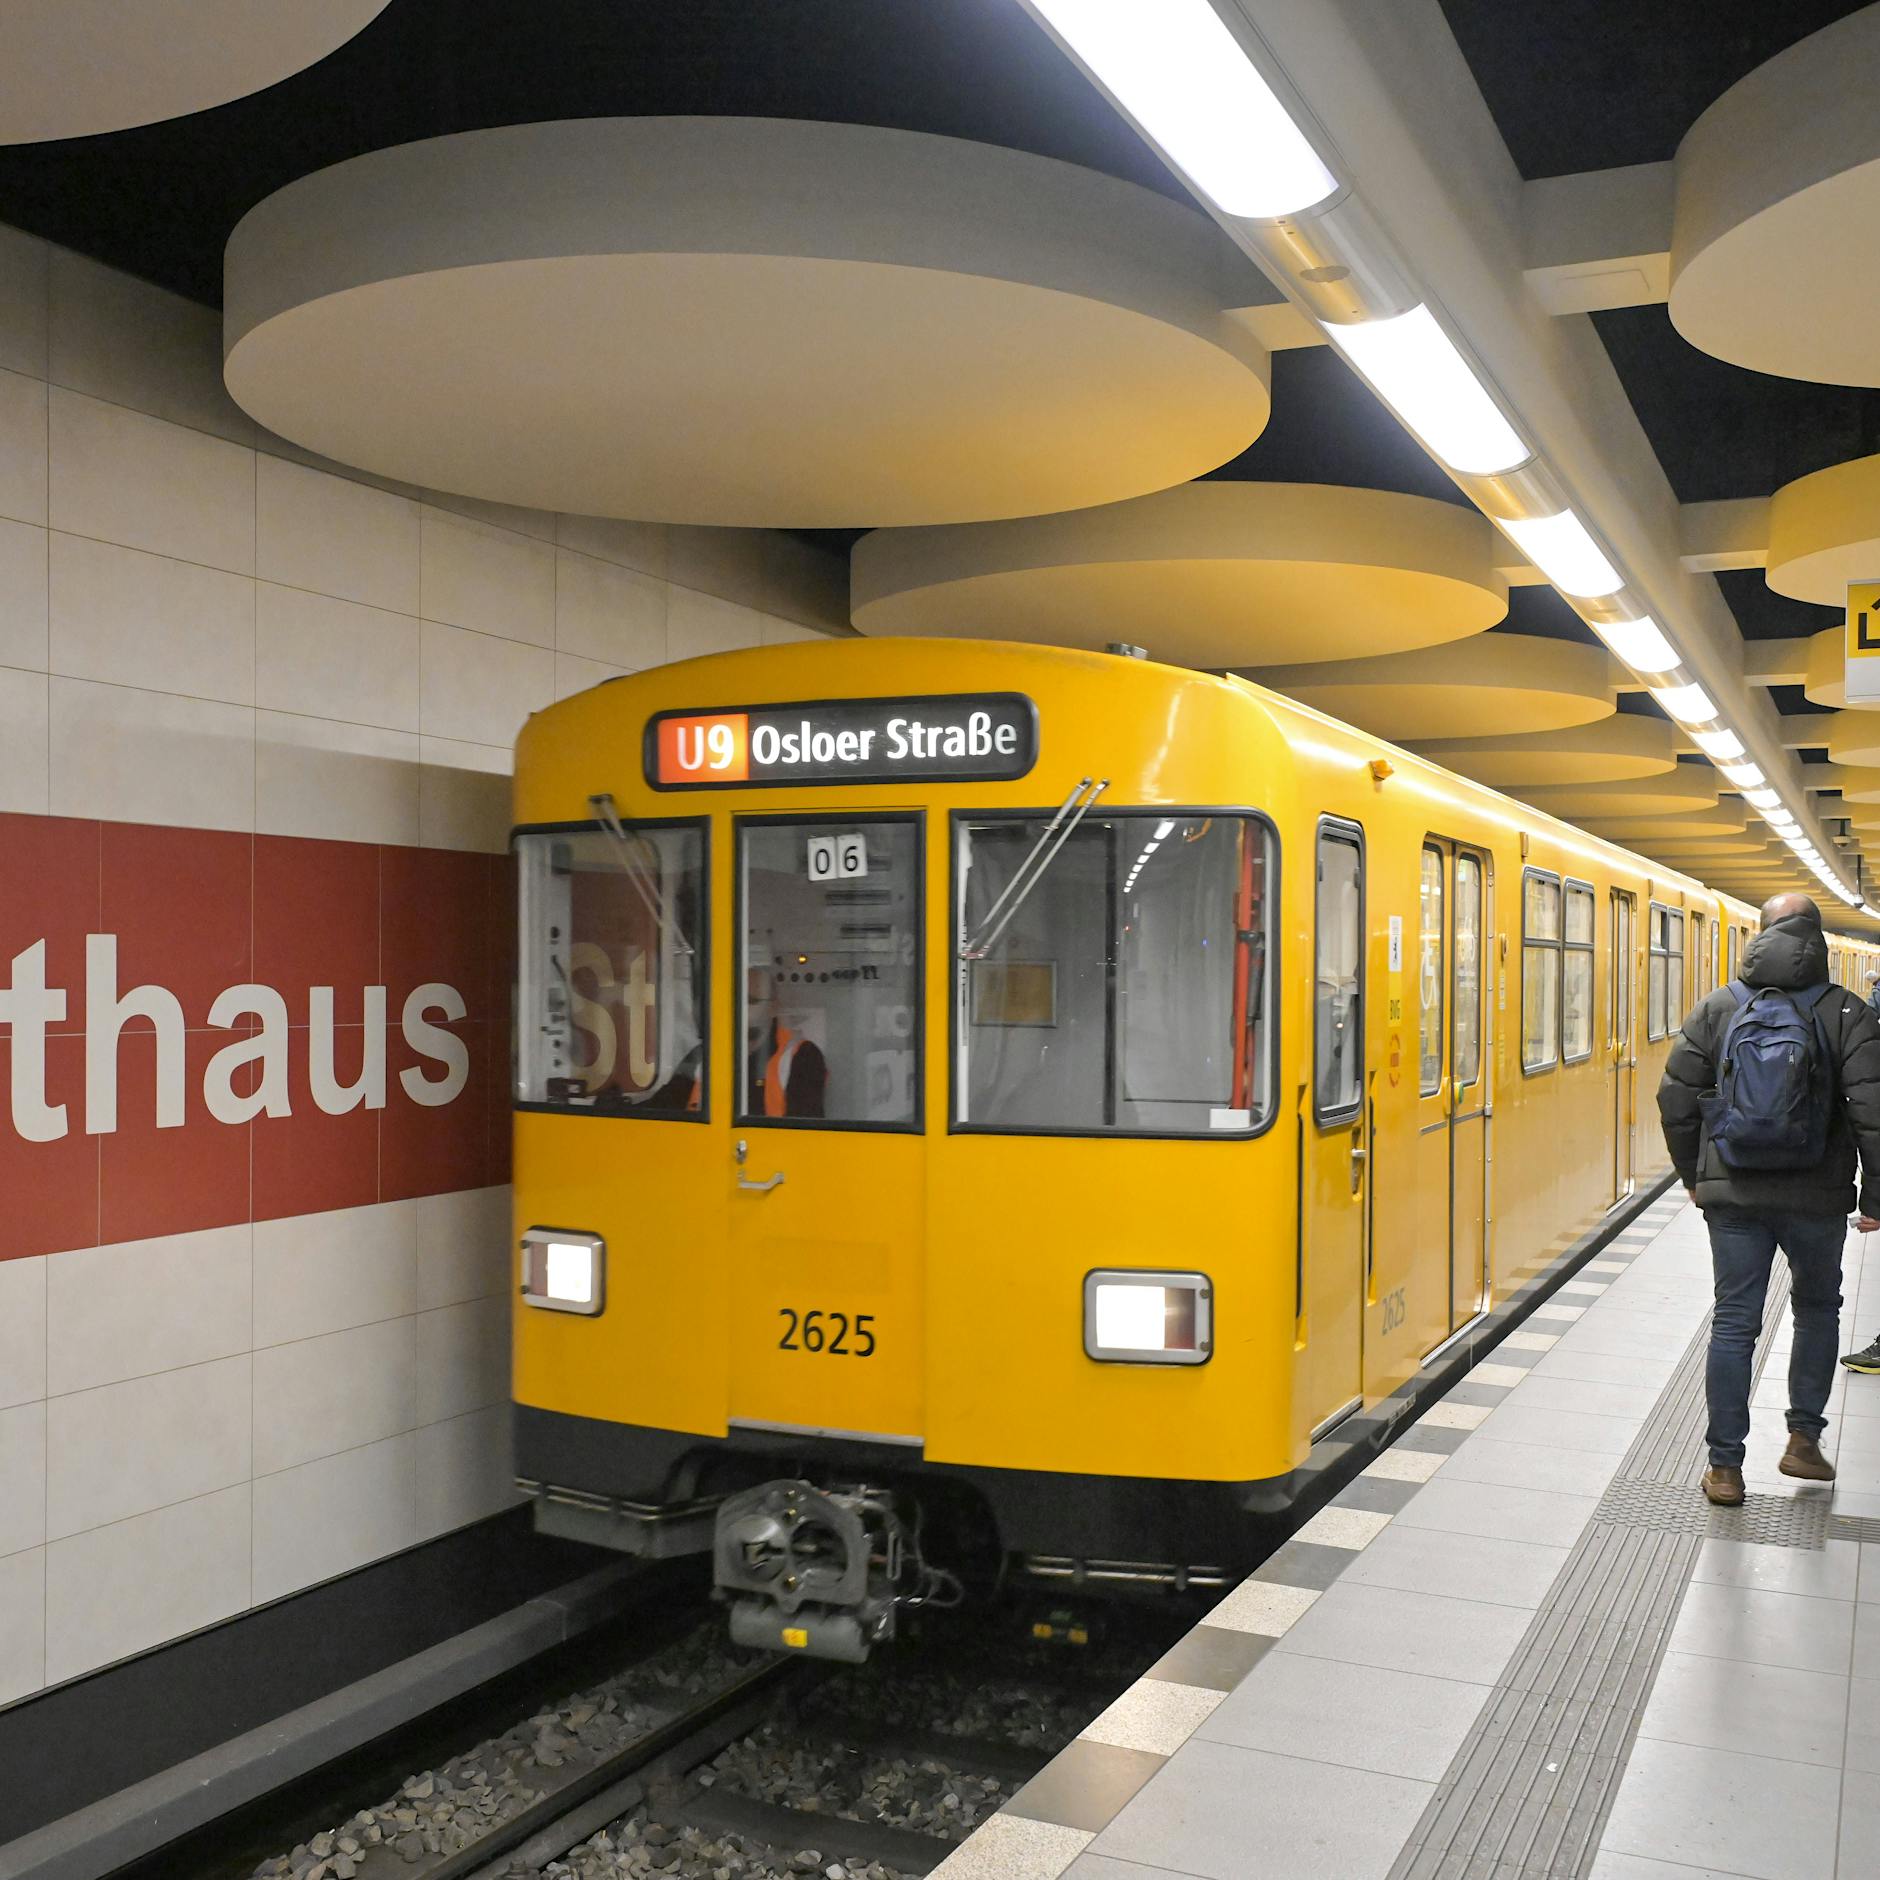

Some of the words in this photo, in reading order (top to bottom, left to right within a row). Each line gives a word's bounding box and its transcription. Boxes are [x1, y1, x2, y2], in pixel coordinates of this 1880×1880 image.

[677, 724, 735, 770] U9
[751, 720, 876, 765] Osloer
[886, 711, 1018, 760] Straße
[814, 844, 860, 876] 06
[0, 933, 470, 1143] thaus
[779, 1308, 875, 1357] 2625
[1381, 1286, 1405, 1337] 2625
